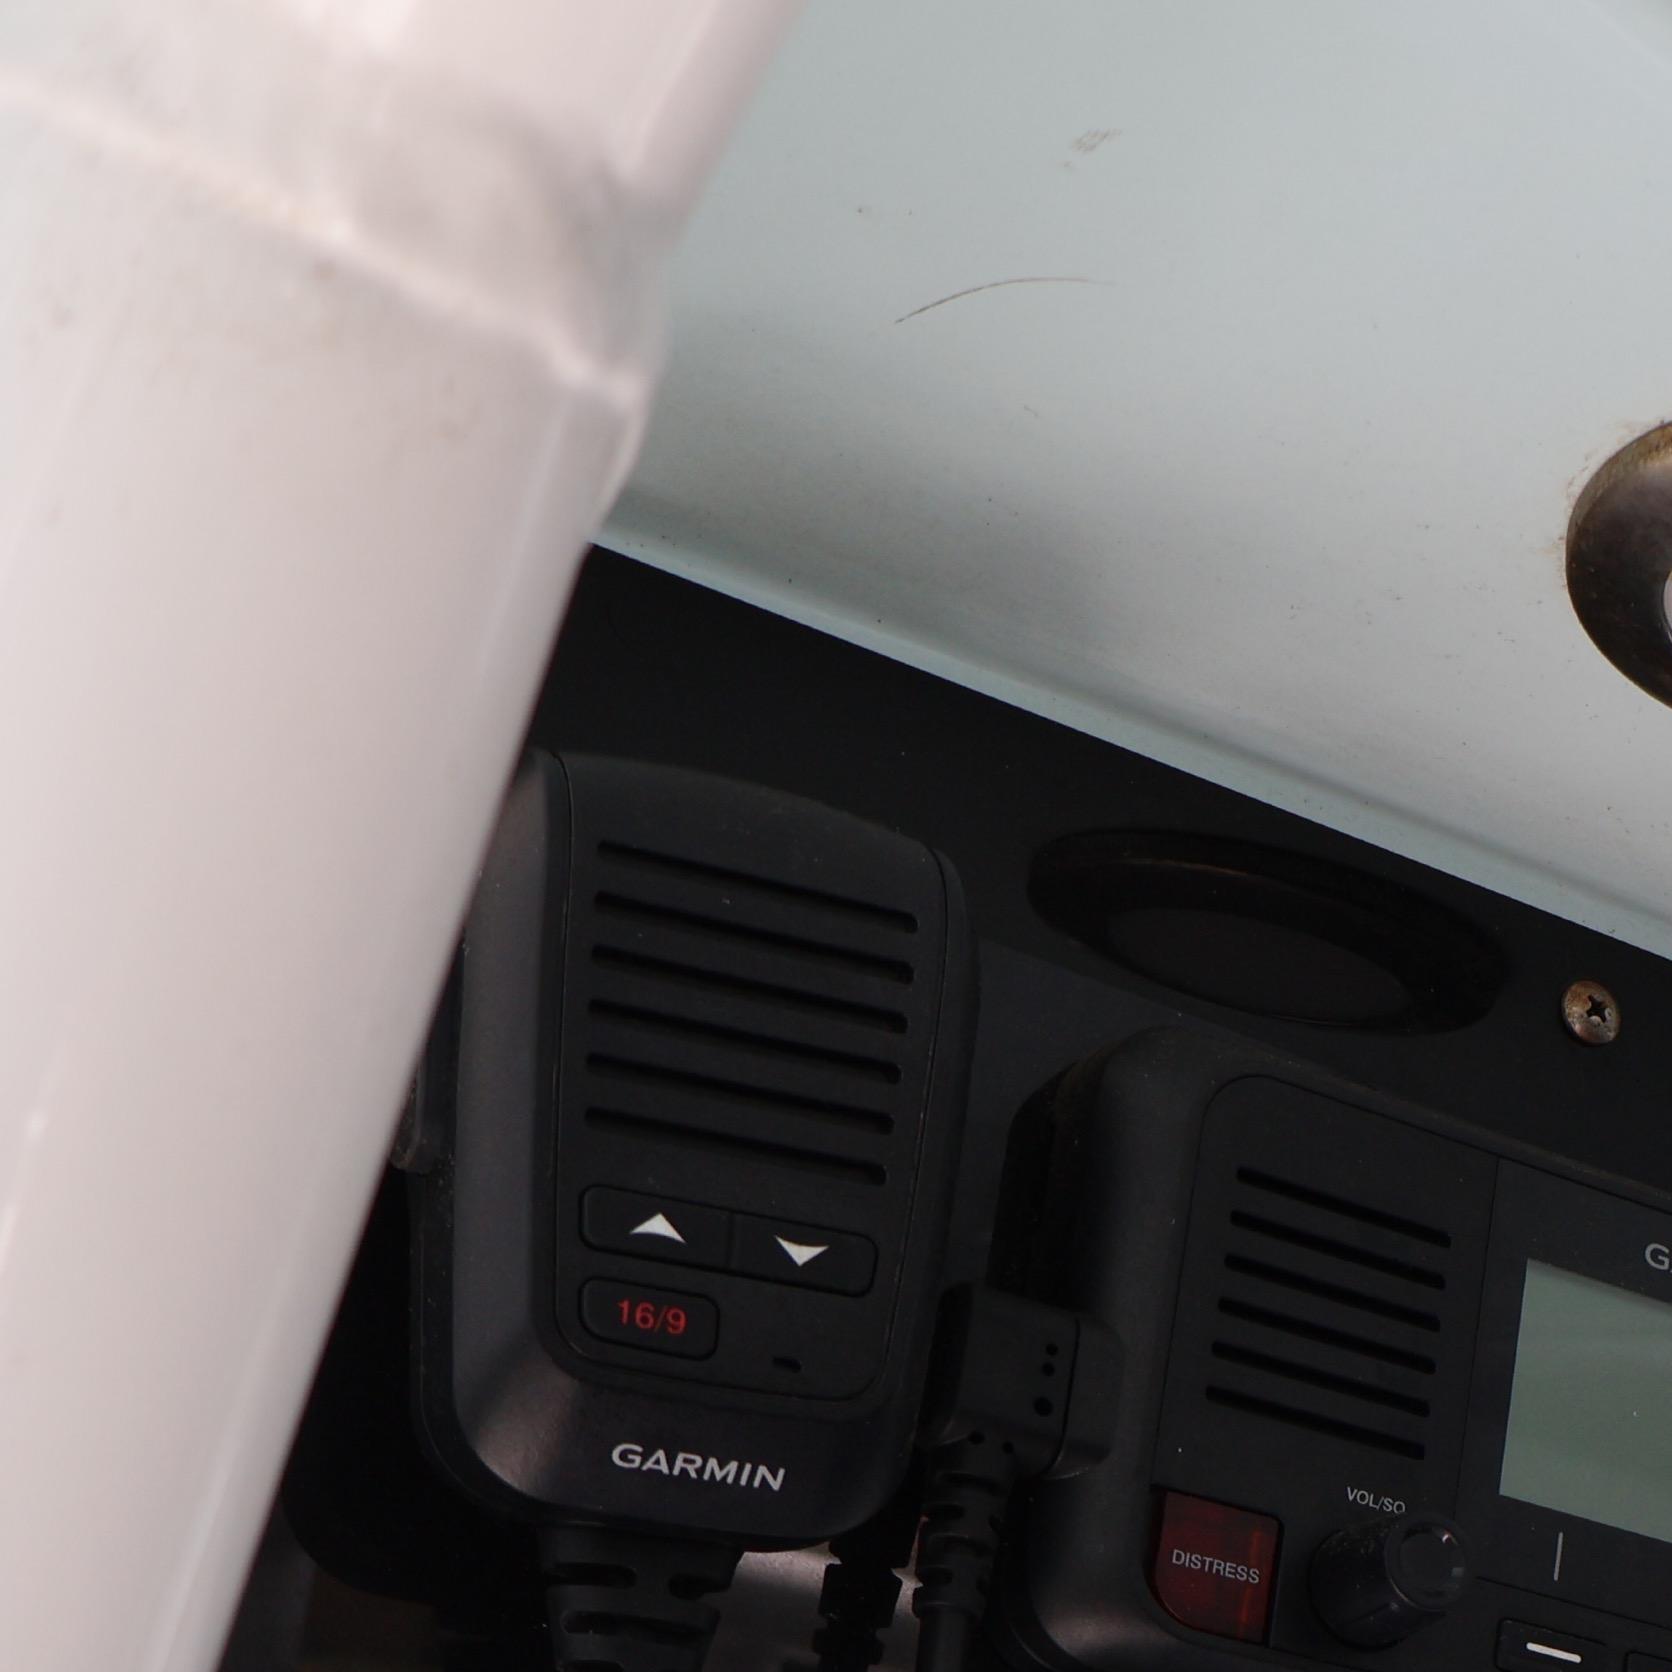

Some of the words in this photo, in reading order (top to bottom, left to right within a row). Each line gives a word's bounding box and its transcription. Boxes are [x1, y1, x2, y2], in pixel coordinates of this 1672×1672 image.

[618, 1299, 688, 1335] 16/9
[611, 1442, 787, 1492] GARMIN
[1171, 1548, 1261, 1584] DISTRESS
